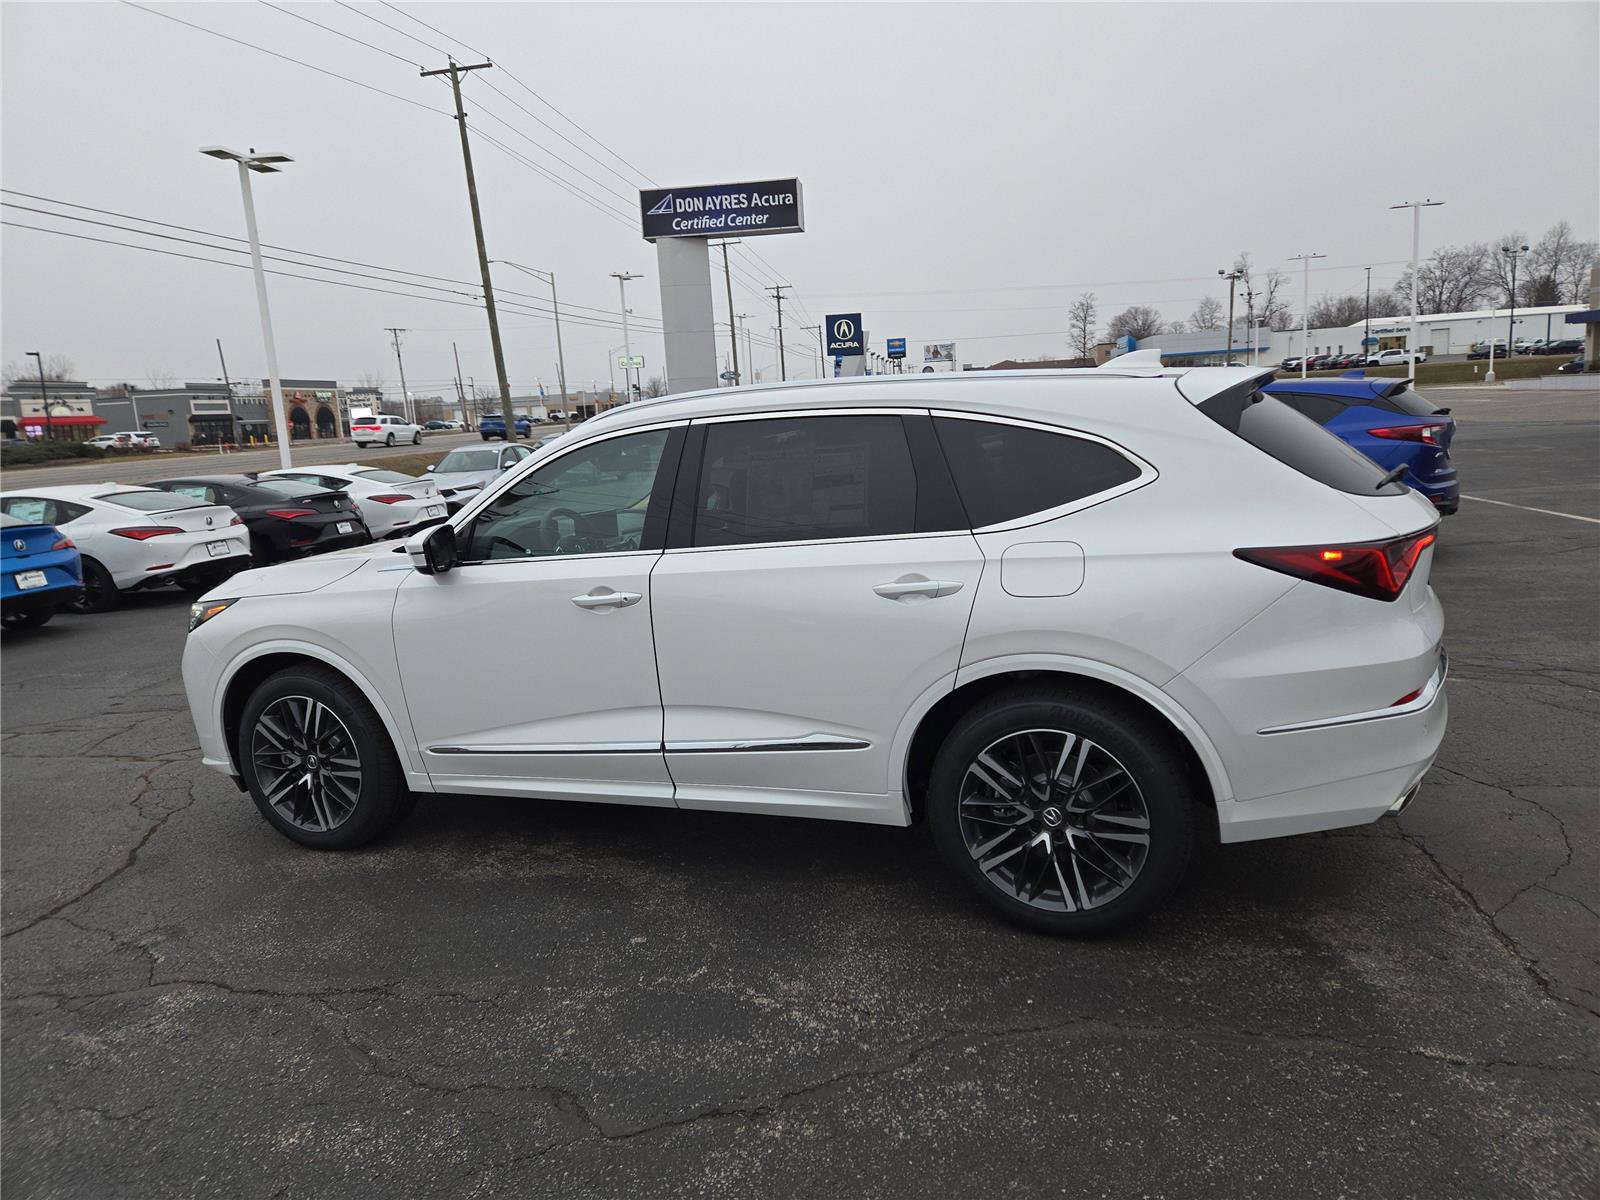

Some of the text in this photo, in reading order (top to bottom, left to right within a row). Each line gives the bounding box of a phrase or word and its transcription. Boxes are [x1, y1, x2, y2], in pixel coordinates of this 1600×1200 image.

[676, 192, 793, 213] DON AYRES Acura
[672, 213, 769, 230] Certified Center
[830, 341, 859, 349] ACURA
